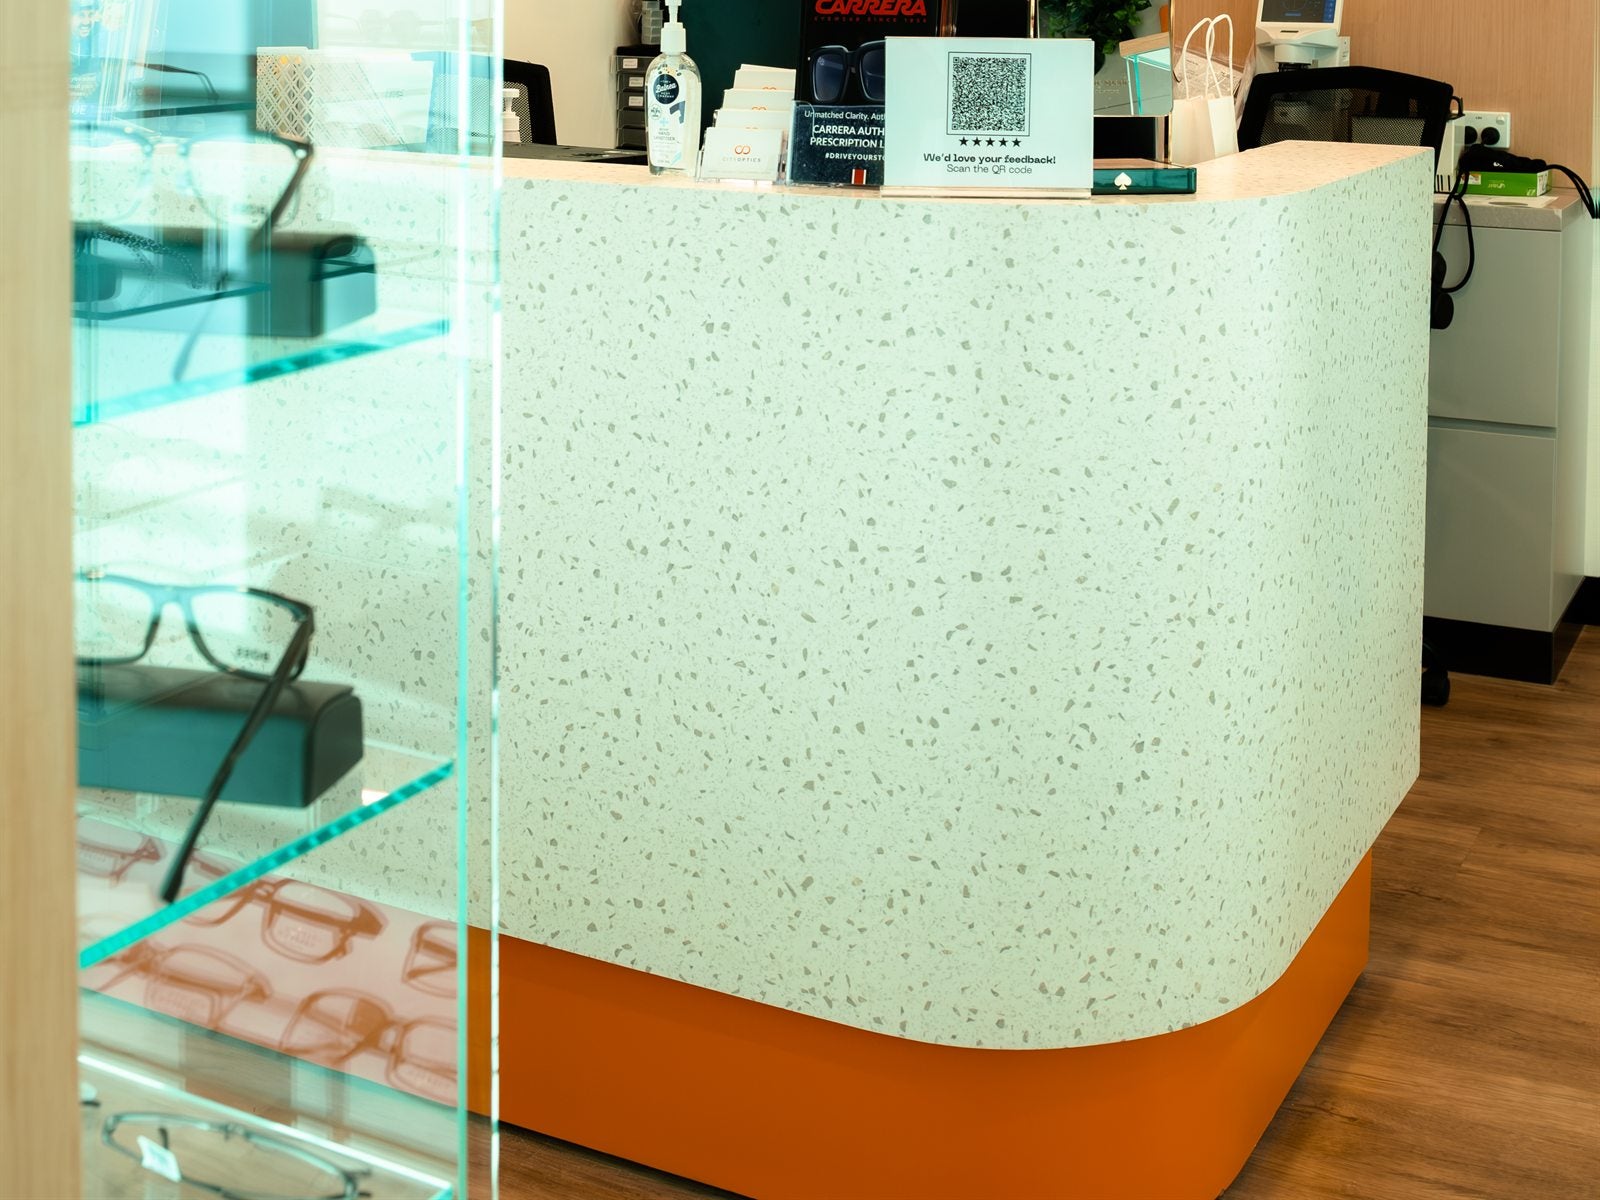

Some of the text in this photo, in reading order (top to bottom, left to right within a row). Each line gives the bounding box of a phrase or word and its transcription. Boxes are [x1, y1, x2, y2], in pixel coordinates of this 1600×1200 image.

[804, 110, 844, 120] Unmatched
[845, 111, 870, 121] Clarity.
[813, 124, 885, 136] CARRERA AUTH
[810, 137, 878, 148] PRESCRIPTION
[923, 152, 1056, 164] We'd love your feedback!
[946, 163, 1033, 175] Scan the QR code
